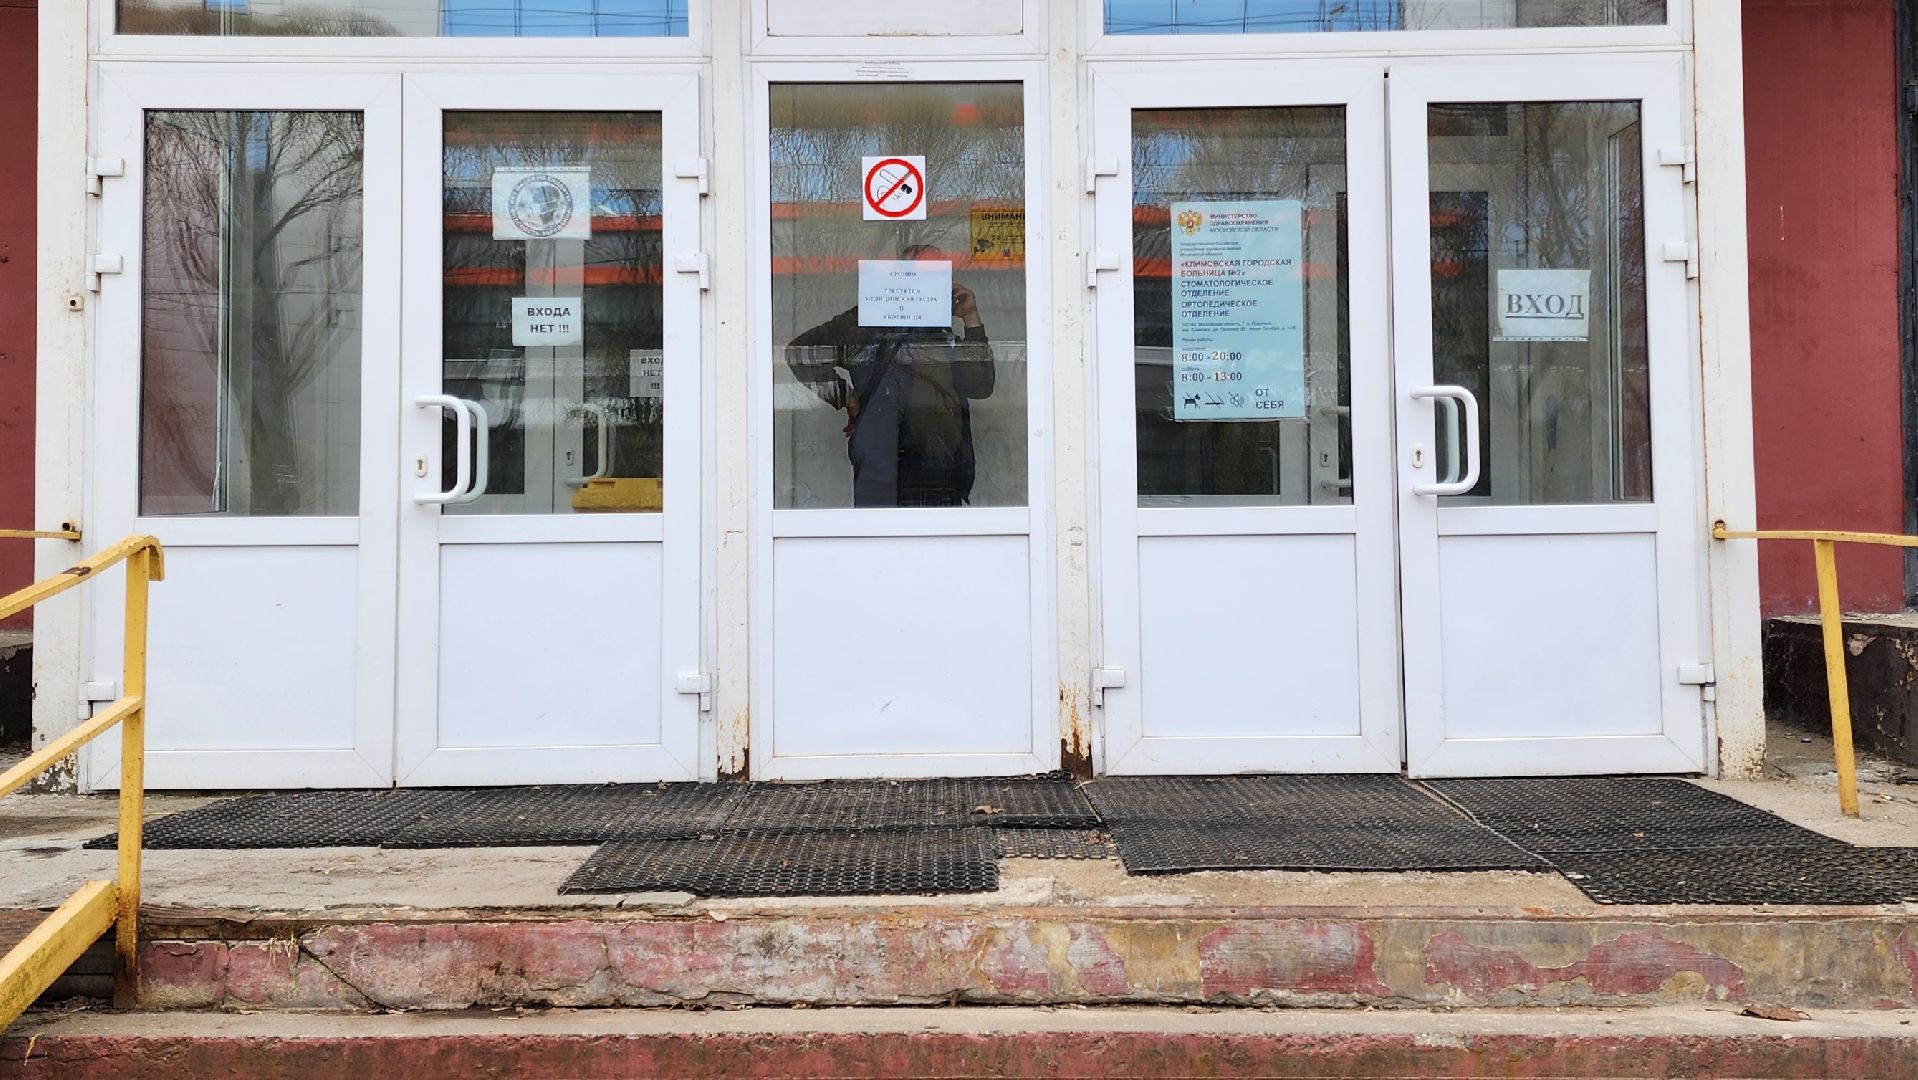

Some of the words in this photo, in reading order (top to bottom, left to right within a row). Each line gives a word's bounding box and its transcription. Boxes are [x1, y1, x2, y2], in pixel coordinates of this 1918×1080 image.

[1242, 258, 1292, 267] ГОРОДСКАЯ
[1180, 269, 1226, 277] БОЛЬНИЦА
[1181, 279, 1273, 288] СТОМАТОЛОГИЧЕСКОЕ
[1181, 289, 1230, 298] ОТДЕЛЕНИЕ
[1181, 299, 1258, 308] ОРТОПЕДИЧЕСКОЕ
[1506, 294, 1584, 318] ВХОД
[527, 307, 571, 318] ВХОДА
[1181, 309, 1231, 319] ОТДЕЛЕНИЕ
[530, 324, 555, 333] НЕТ
[558, 324, 569, 333] !!!
[1181, 353, 1204, 362] 8:00
[1212, 351, 1242, 361] 20:00
[1181, 373, 1204, 382] 8:00
[1214, 372, 1242, 382] 13:00
[1255, 388, 1270, 397] ОТ
[1255, 400, 1285, 409] СЕБЯ
